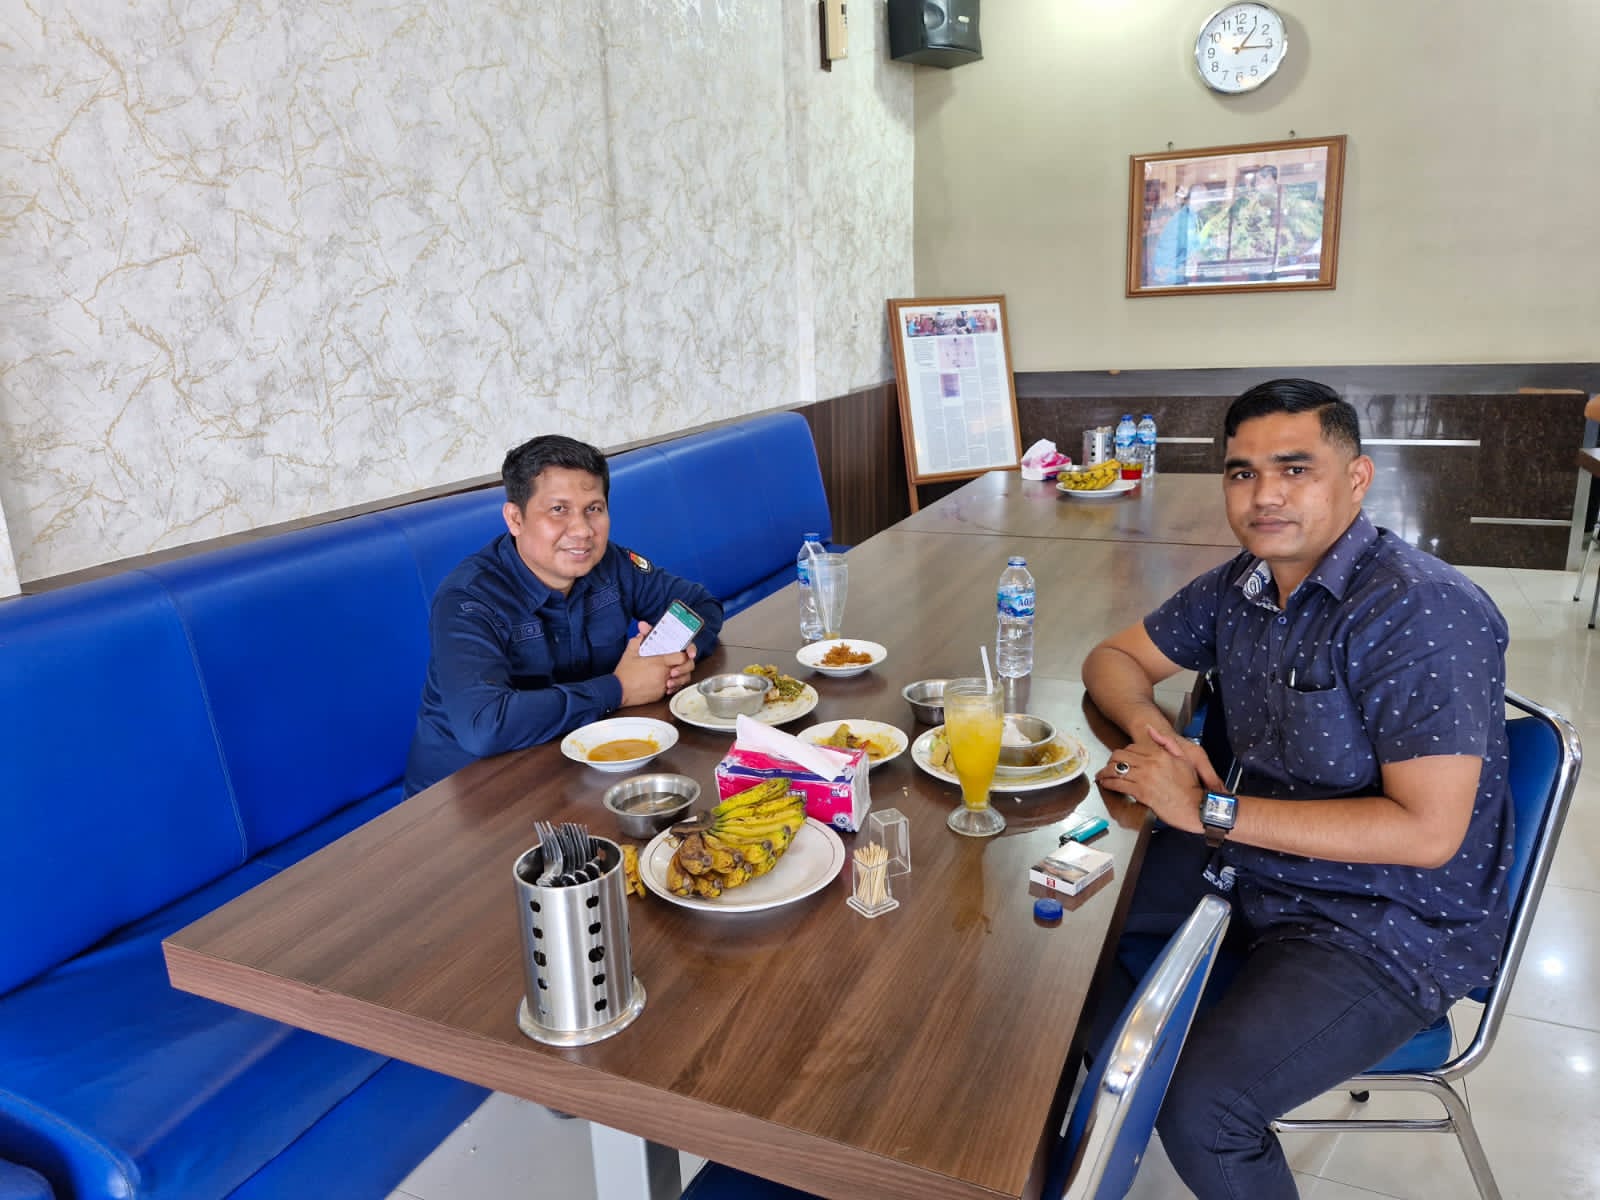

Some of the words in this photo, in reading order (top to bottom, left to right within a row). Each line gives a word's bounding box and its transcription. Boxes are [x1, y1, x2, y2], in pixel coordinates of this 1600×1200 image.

[1234, 13, 1247, 24] 12
[1222, 19, 1230, 32] 11
[1262, 23, 1270, 36] 2
[1209, 32, 1222, 44] 10
[1264, 38, 1273, 49] 3
[1207, 47, 1216, 58] 9
[1260, 53, 1268, 64] 4
[1211, 61, 1219, 72] 8
[1250, 65, 1258, 76] 5
[1222, 70, 1230, 80] 7
[1236, 72, 1244, 83] 6
